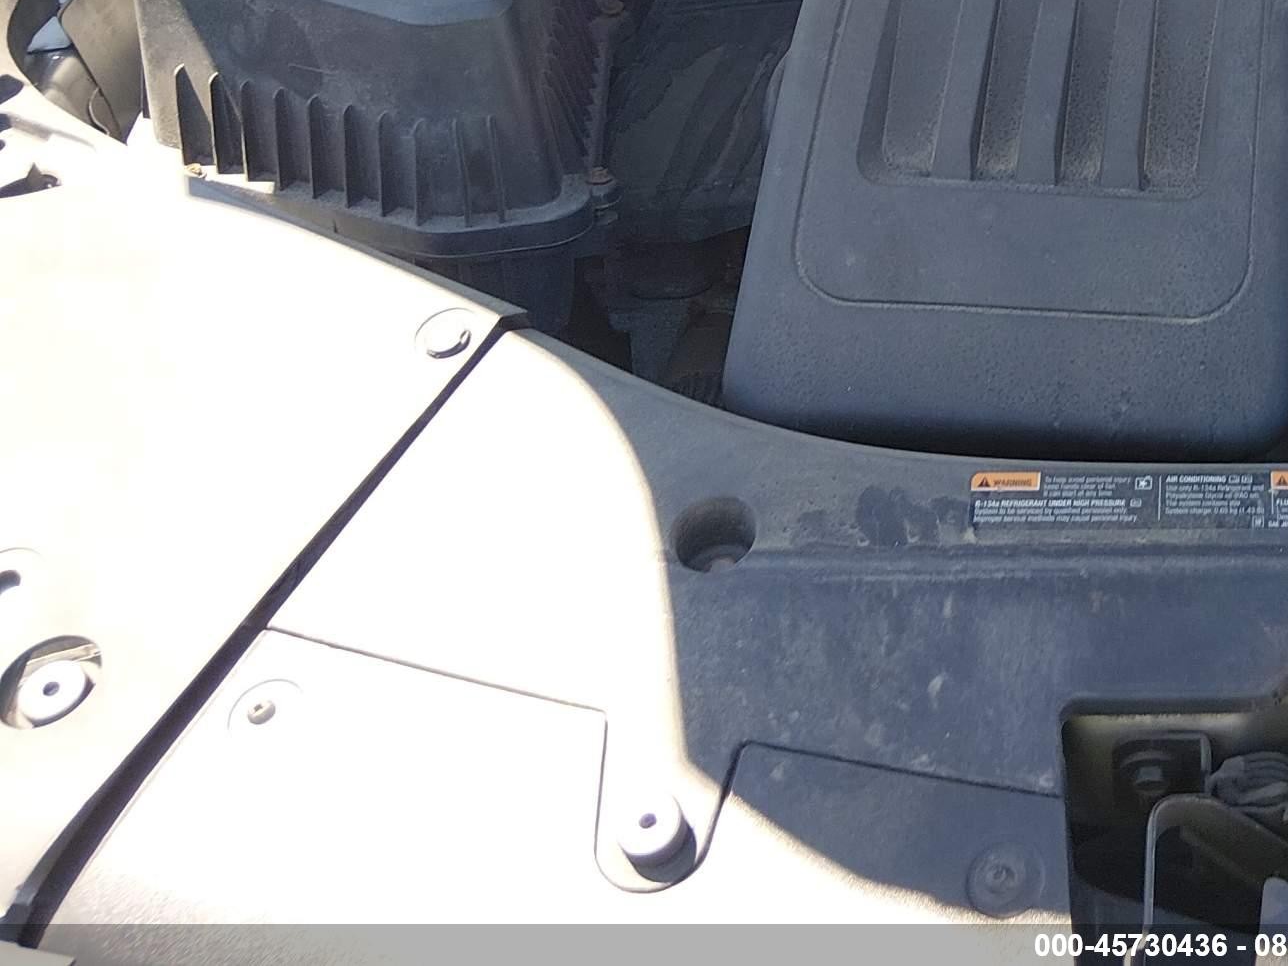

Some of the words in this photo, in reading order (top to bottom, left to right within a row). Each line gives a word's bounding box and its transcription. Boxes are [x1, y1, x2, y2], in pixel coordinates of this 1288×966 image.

[993, 478, 1032, 487] WARNING
[1165, 475, 1178, 483] AIR
[1179, 475, 1227, 483] CONDITIONING
